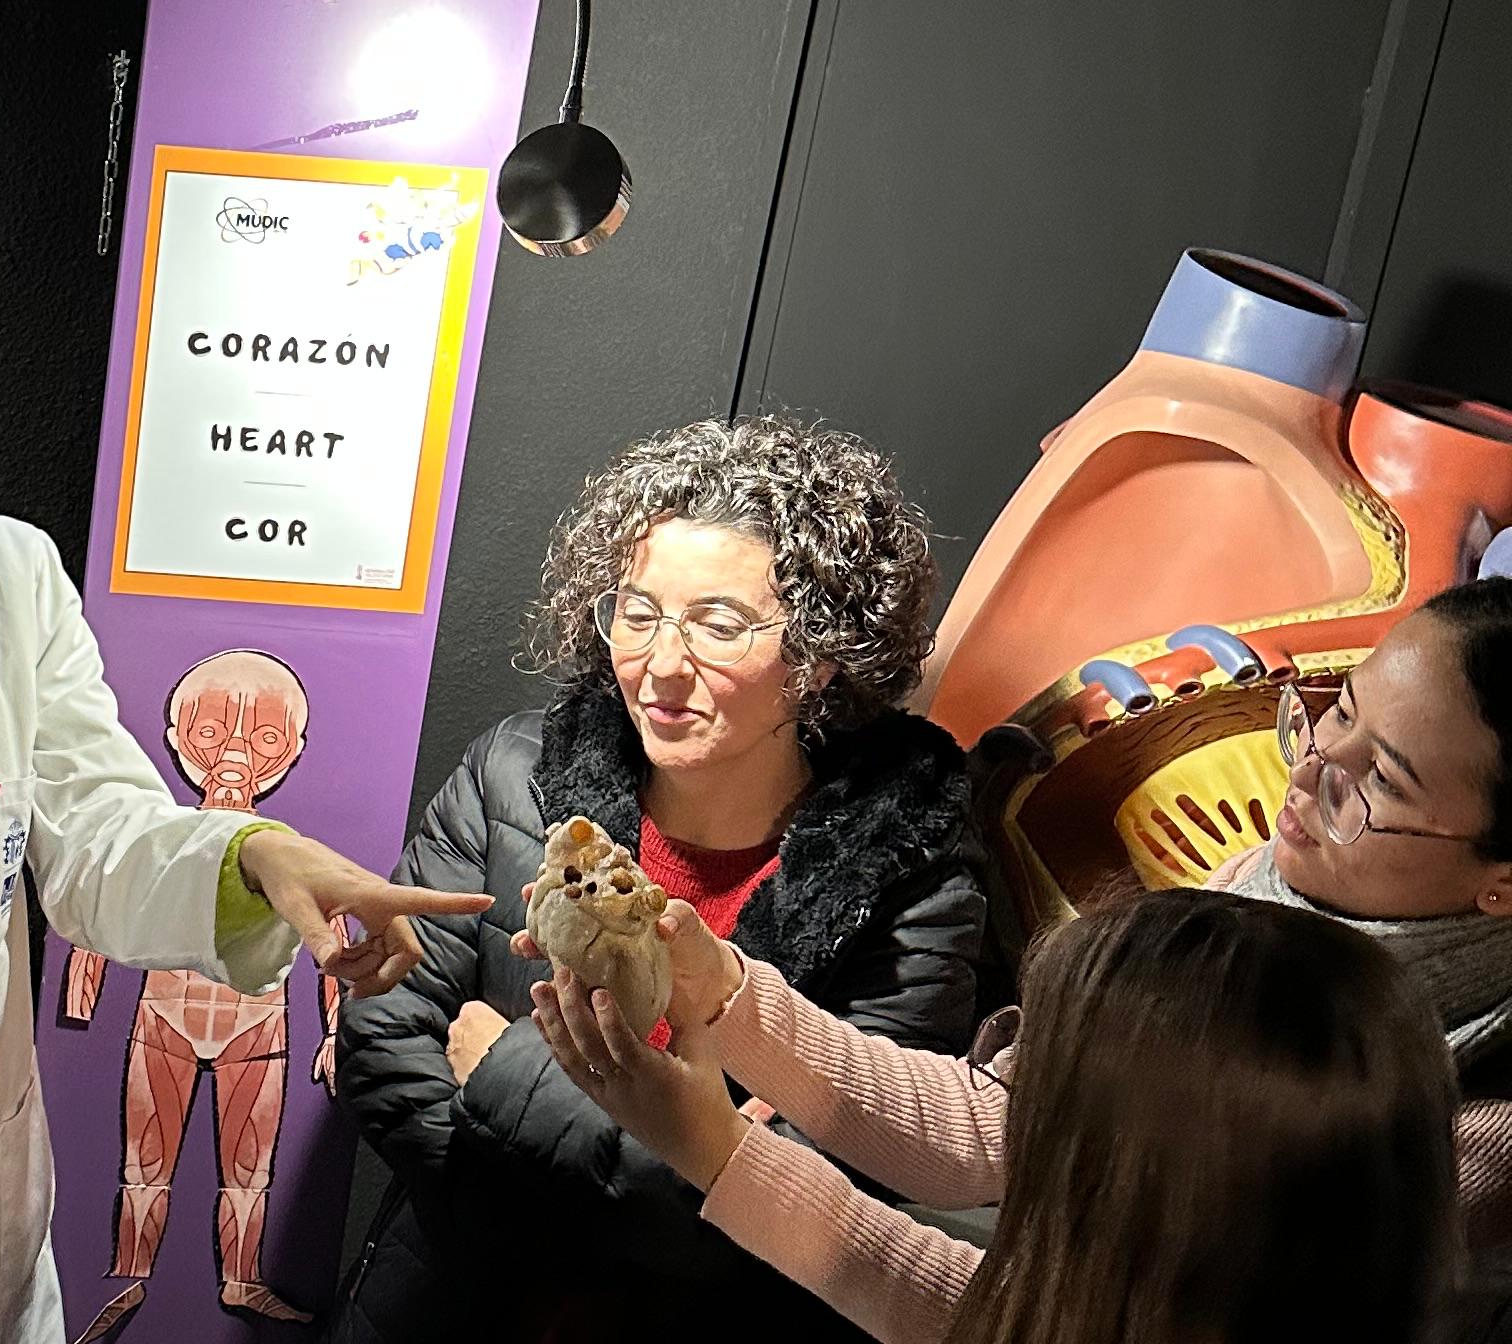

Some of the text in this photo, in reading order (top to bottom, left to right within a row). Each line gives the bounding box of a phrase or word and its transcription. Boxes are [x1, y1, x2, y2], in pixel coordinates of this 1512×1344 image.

[236, 213, 290, 230] MUDIC
[187, 332, 390, 369] CORAZÓN
[210, 423, 345, 459] HEART
[225, 518, 308, 547] COR
